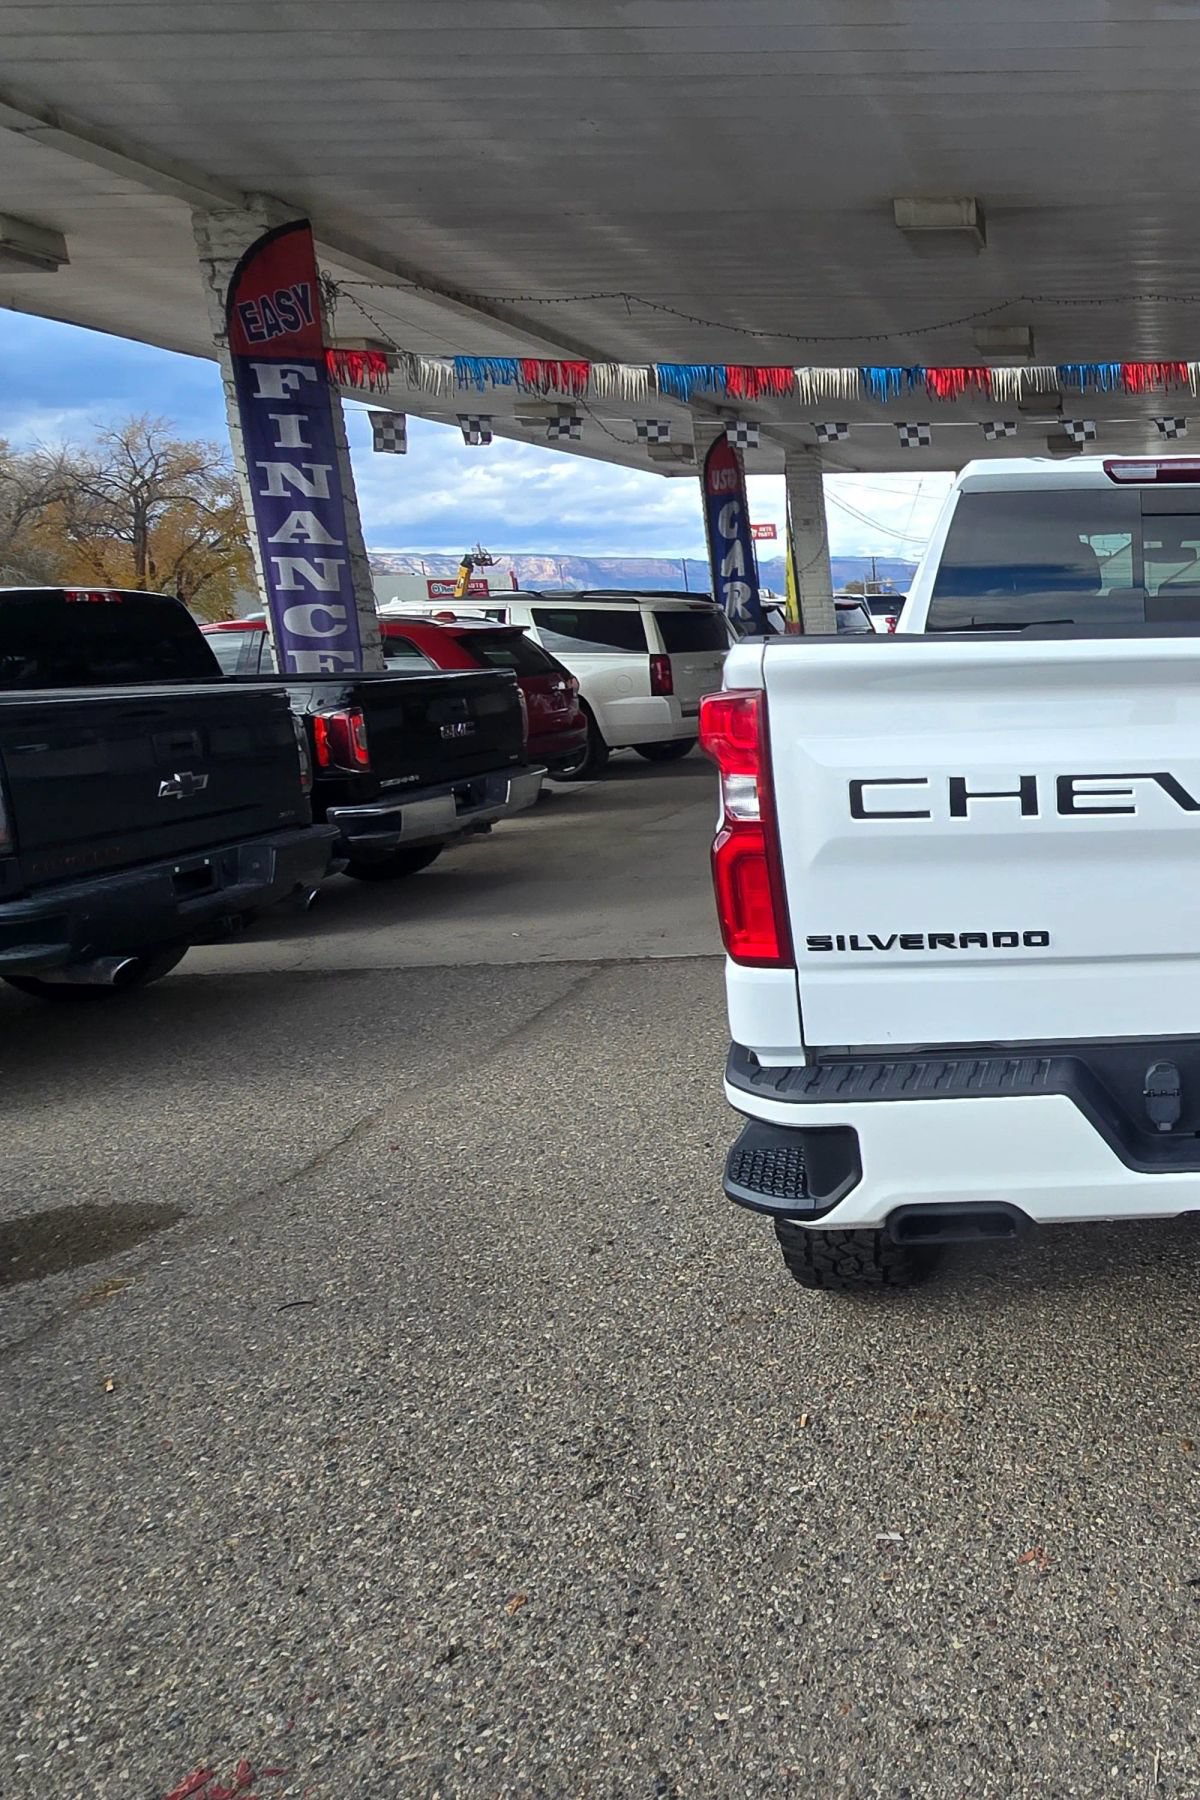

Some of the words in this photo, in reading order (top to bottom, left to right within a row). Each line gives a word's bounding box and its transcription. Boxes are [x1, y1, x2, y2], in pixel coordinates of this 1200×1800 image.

[237, 282, 317, 345] EASY
[249, 362, 356, 673] FINANCE
[806, 930, 1050, 952] SILVERADO
